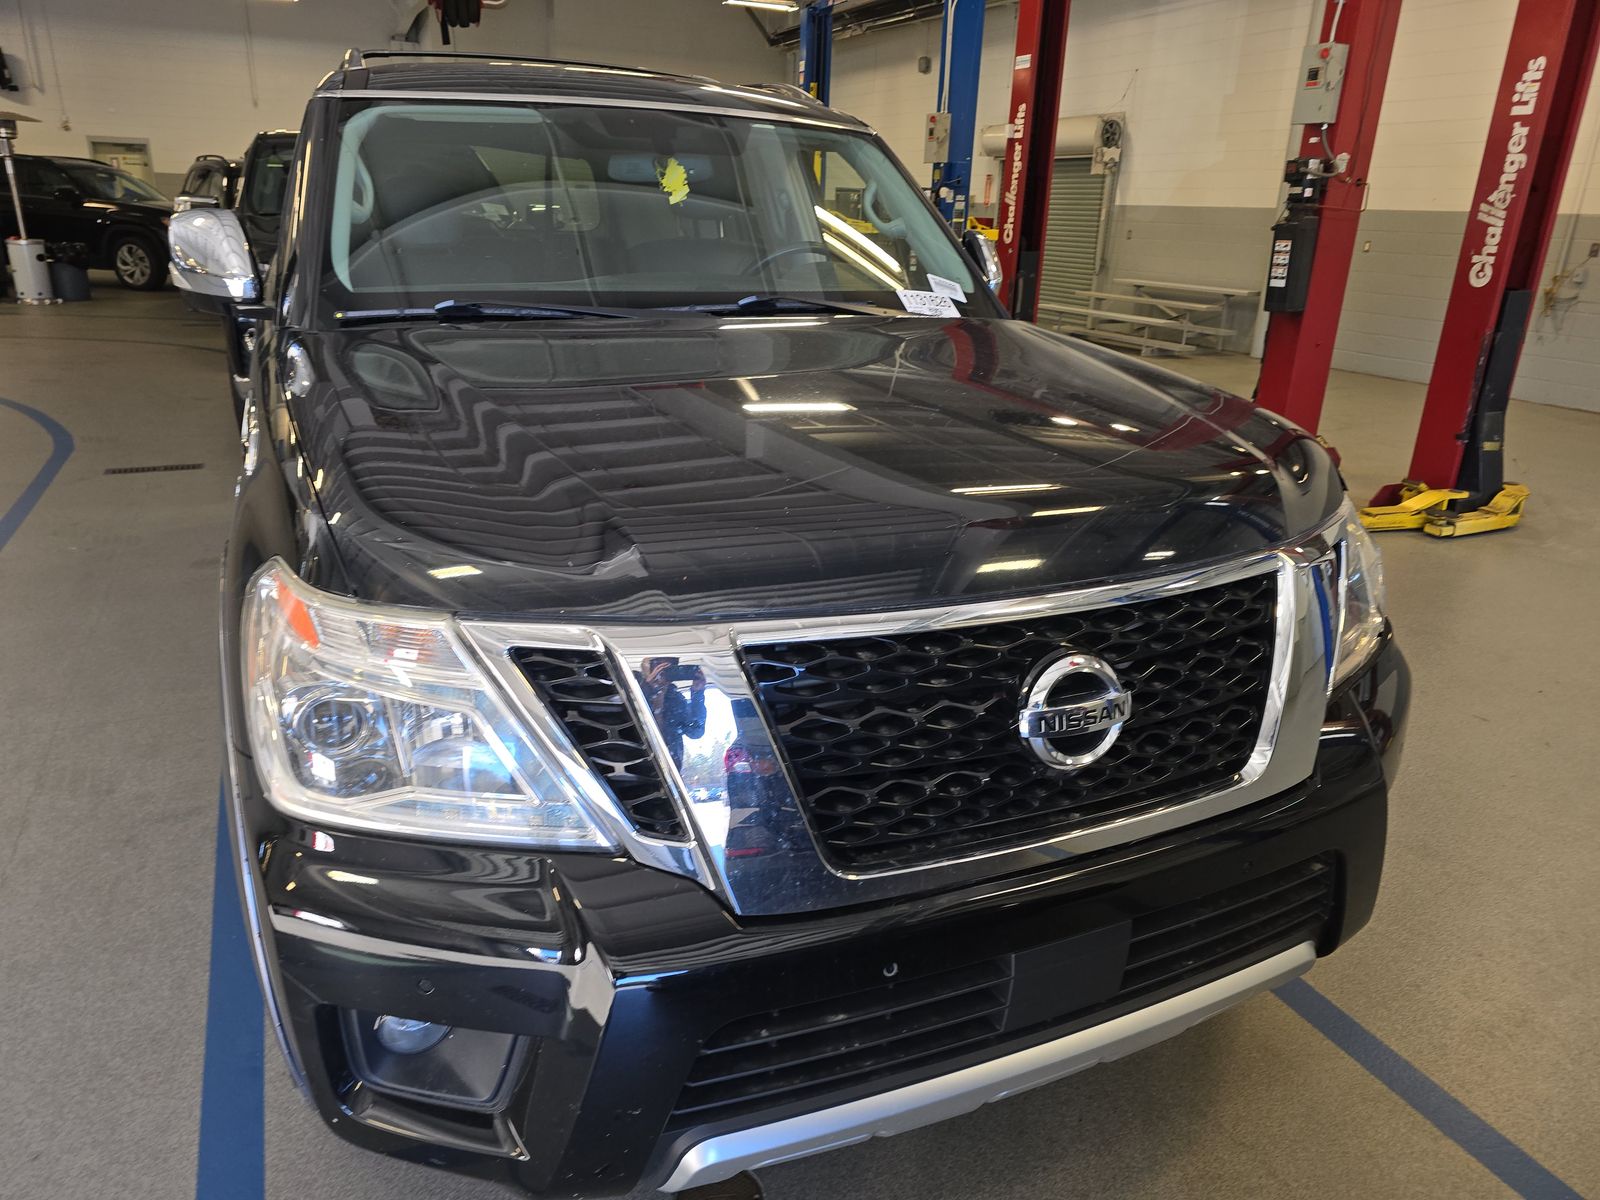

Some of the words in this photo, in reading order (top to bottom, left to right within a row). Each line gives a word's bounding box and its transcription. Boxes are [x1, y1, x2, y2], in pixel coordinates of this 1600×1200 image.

[1003, 141, 1022, 244] Challenger
[1014, 102, 1027, 139] Lifts
[1469, 121, 1530, 288] Challenger
[1510, 55, 1547, 116] Lifts
[1039, 700, 1128, 734] NISSAN
